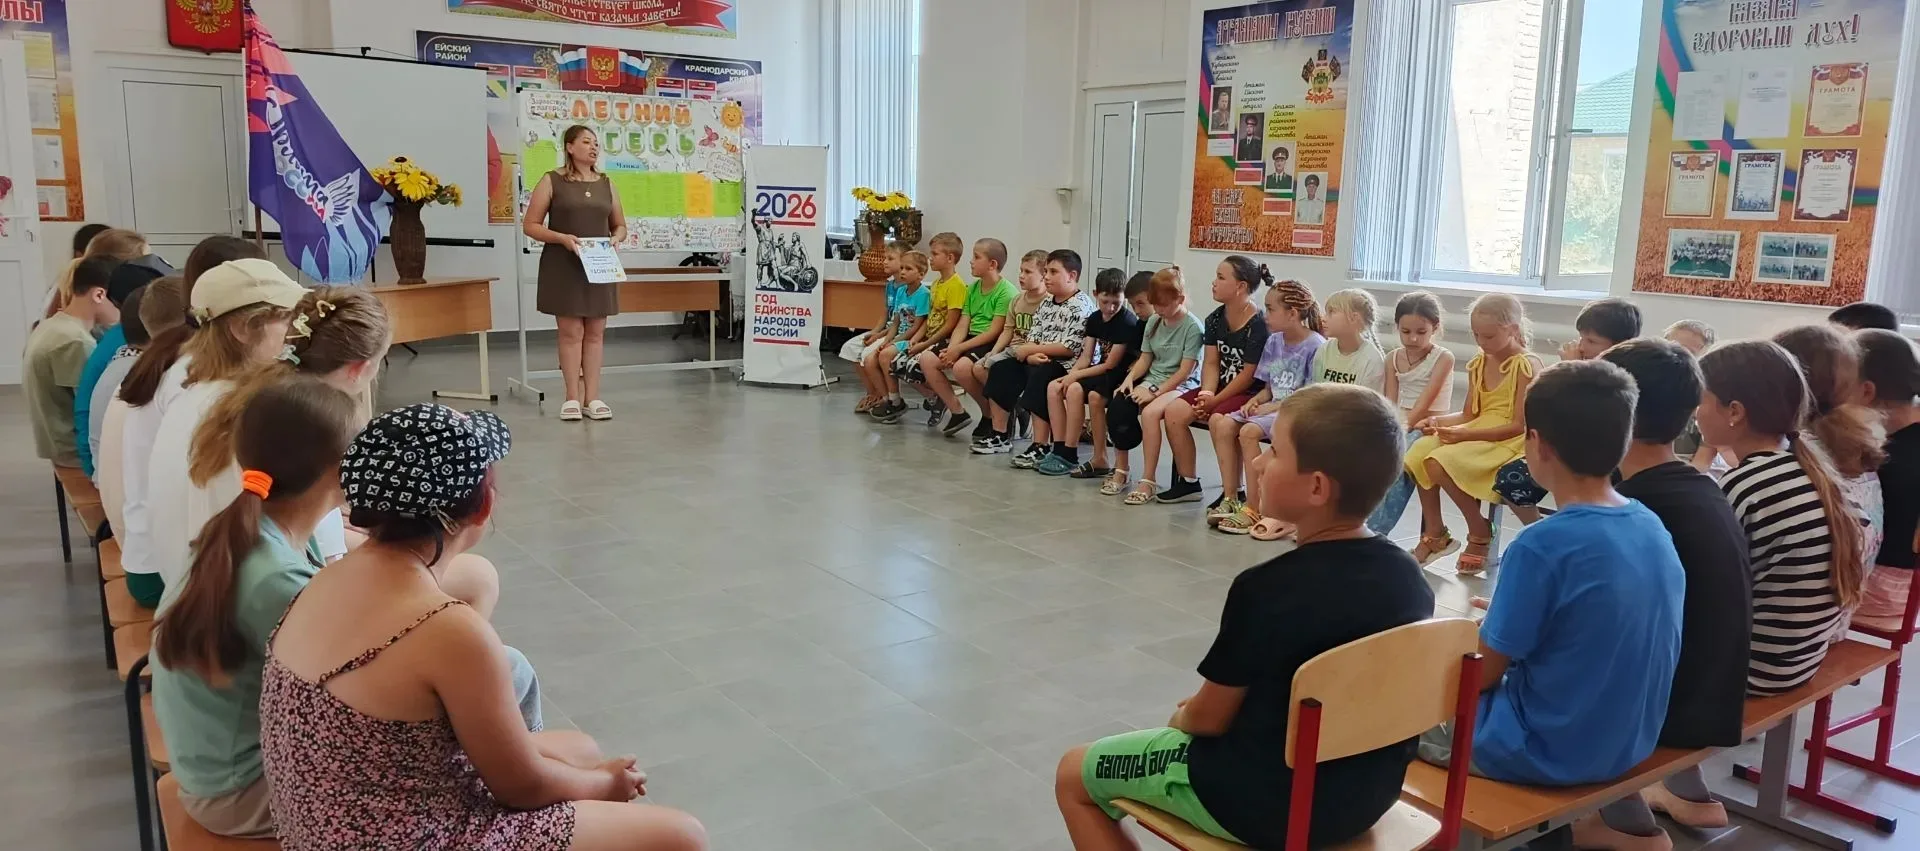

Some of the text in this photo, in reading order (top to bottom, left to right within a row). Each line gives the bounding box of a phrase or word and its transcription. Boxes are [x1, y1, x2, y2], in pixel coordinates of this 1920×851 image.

[0, 0, 44, 23] ЛЫ
[434, 43, 472, 53] ЕЙСКИЙ
[435, 52, 467, 61] РАЙОН
[685, 64, 749, 76] КРАСНОДАРСКИЙ
[572, 99, 691, 122] ЛЕТНИЙ
[606, 132, 695, 152] ГЕРЬ
[755, 192, 817, 219] 2026
[755, 293, 777, 305] ГОД
[754, 305, 811, 317] ЕДИНСТВА
[754, 316, 806, 328] НАРОДОВ
[753, 326, 798, 338] РОССИИ
[1324, 369, 1356, 385] FRESH
